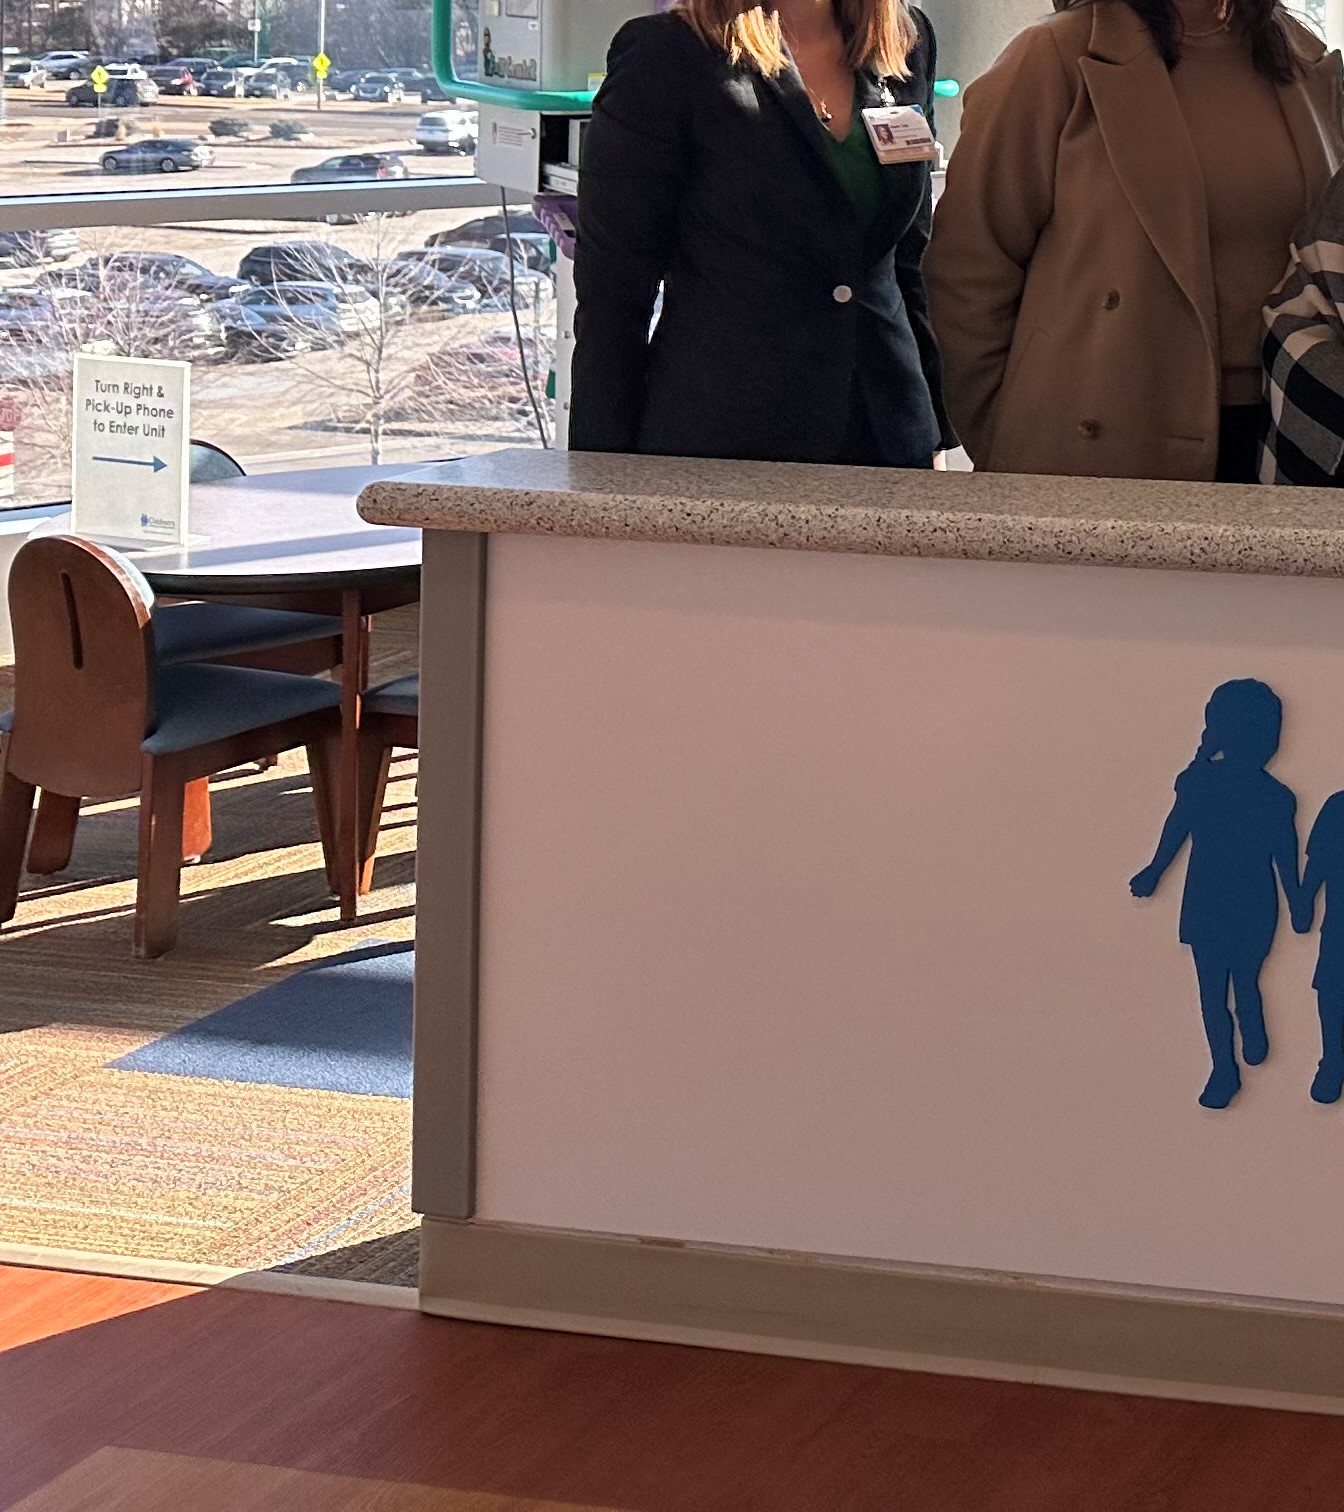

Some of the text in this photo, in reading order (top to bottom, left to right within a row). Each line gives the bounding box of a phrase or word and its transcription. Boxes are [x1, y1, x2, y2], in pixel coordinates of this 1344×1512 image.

[95, 380, 165, 398] Turn Right &
[85, 398, 174, 419] Pick-Up Phone
[93, 419, 165, 438] to Enter Unit
